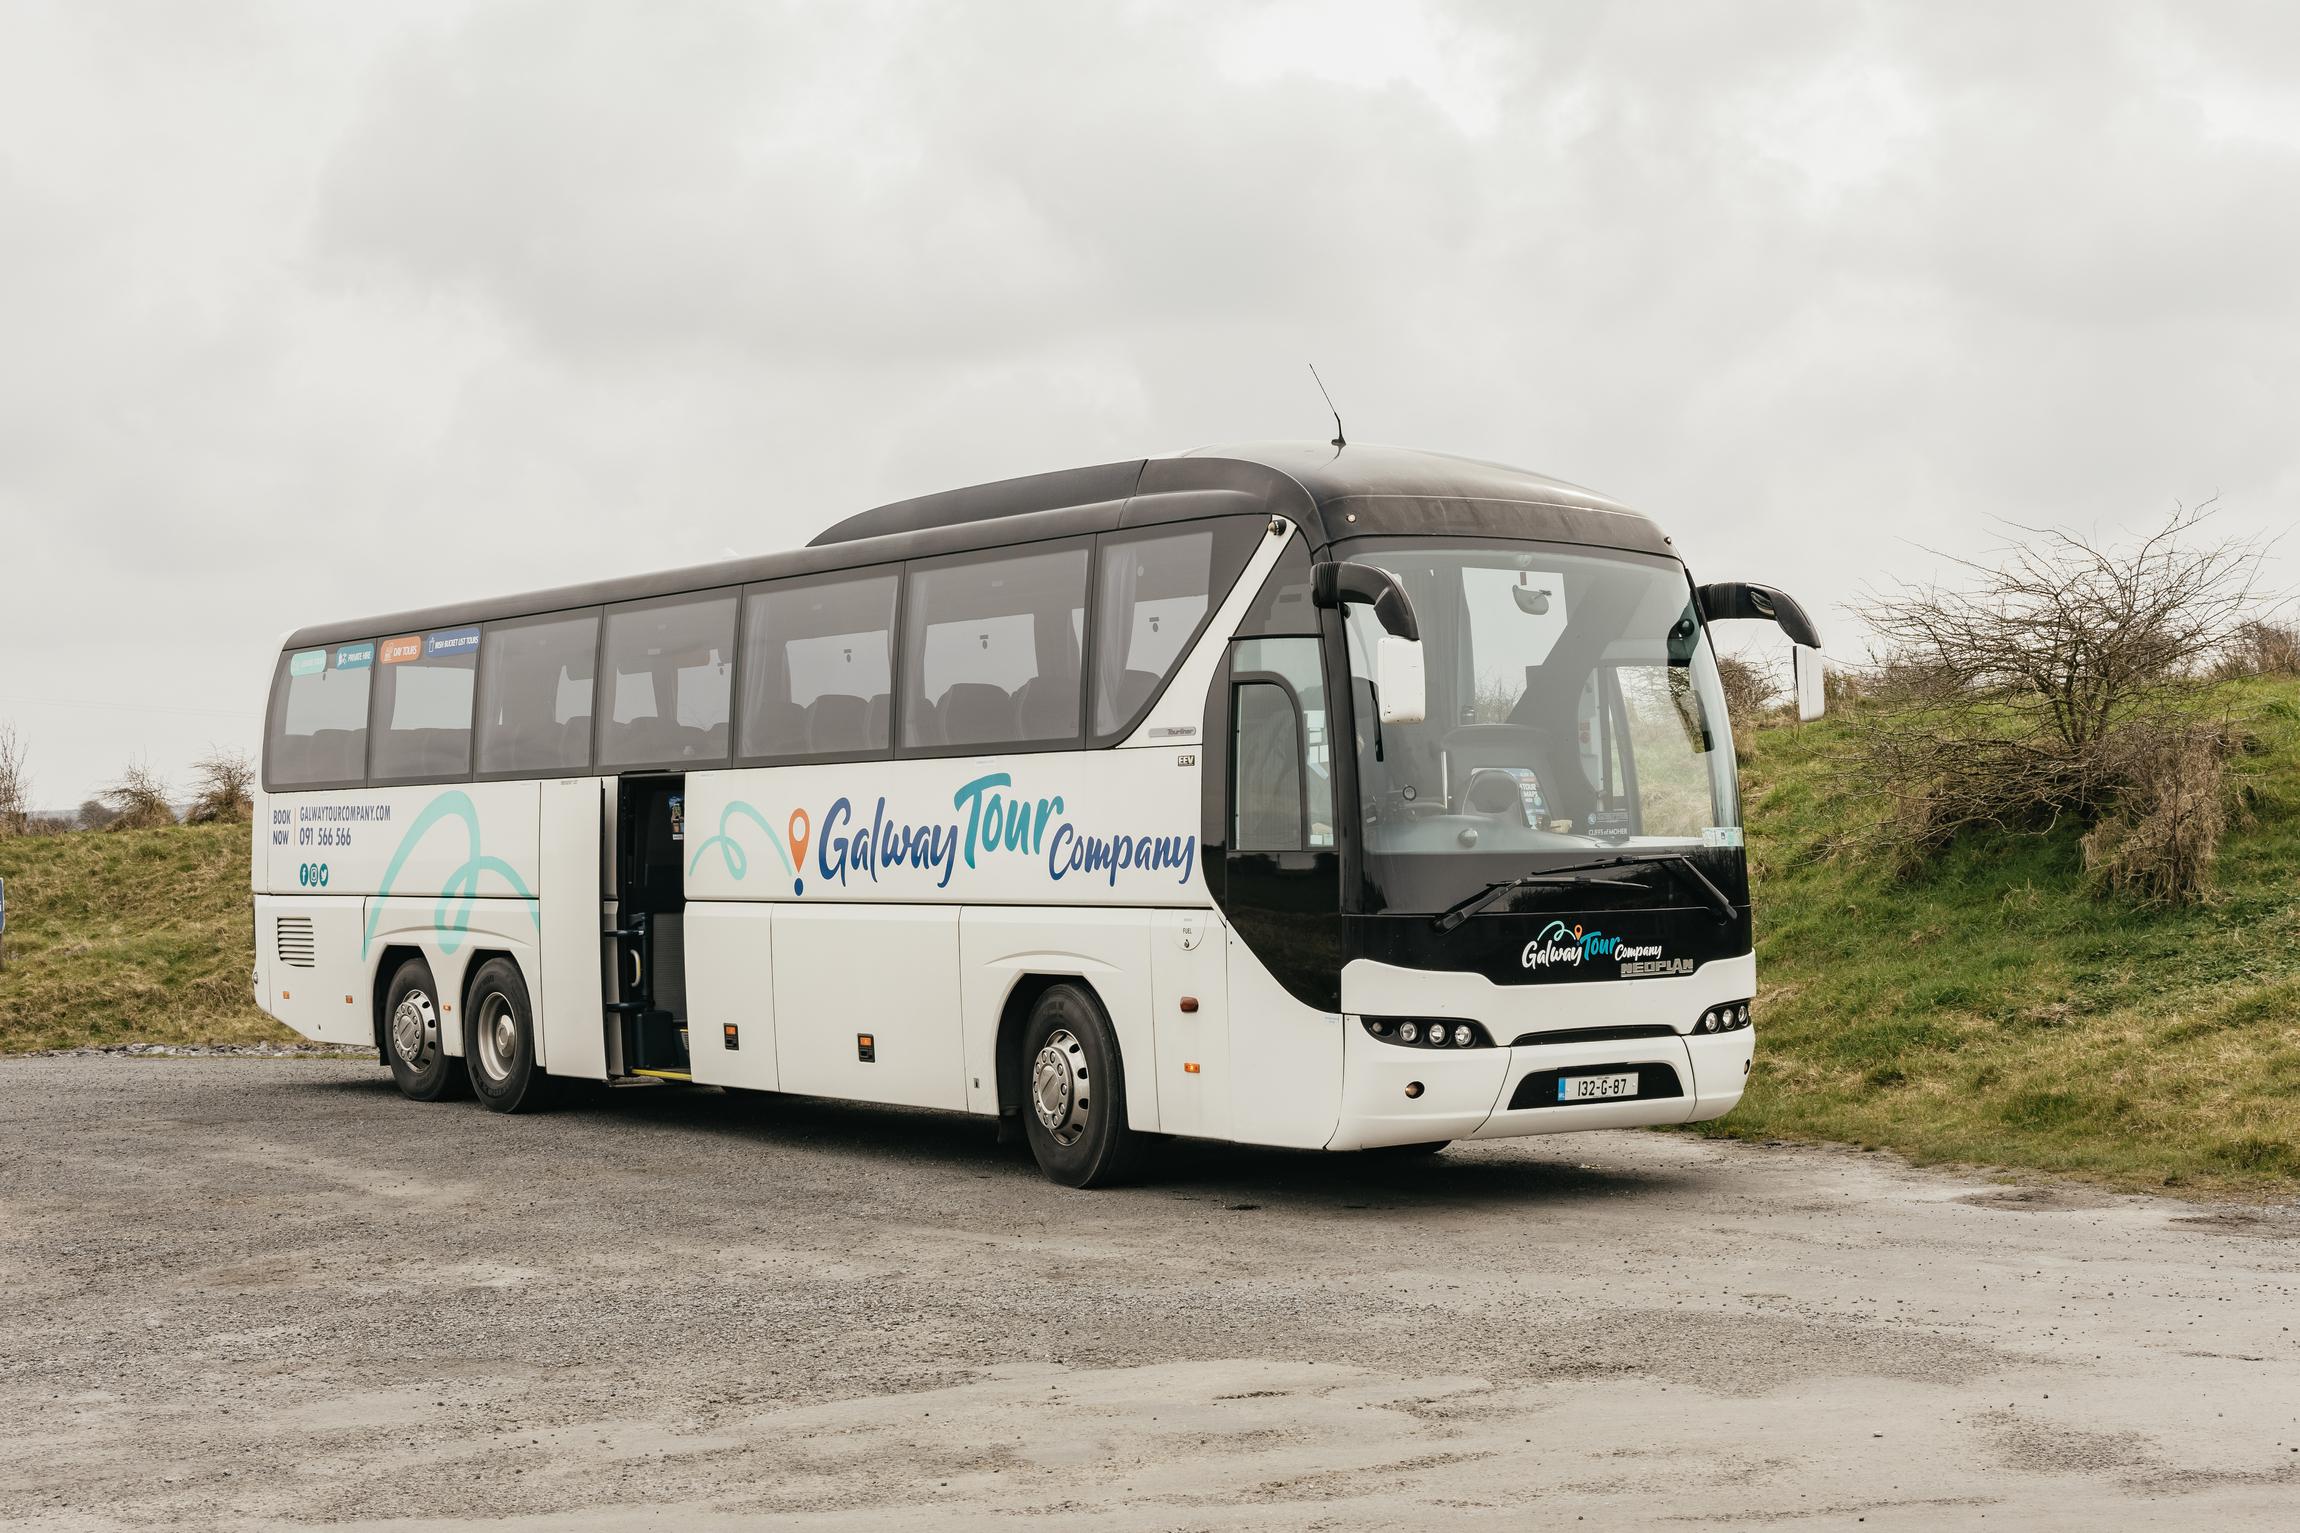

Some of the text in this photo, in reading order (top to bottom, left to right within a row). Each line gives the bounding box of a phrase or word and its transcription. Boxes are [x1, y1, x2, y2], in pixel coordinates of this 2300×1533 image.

[466, 636, 479, 644] TOURS
[348, 652, 363, 662] PRIVATE
[393, 646, 417, 656] DAY TOURS
[1167, 728, 1194, 736] Tourliner
[1178, 755, 1194, 765] EEV
[273, 809, 291, 825] BOOK
[299, 805, 391, 822] GALWAYTOURCOMPANY.COM
[272, 830, 289, 846] NOW
[299, 827, 352, 846] 091 566 566
[818, 772, 1196, 888] Galway Tour Company
[1182, 927, 1192, 935] FUEL
[1521, 931, 1663, 970] Galway Tour Company
[1620, 958, 1694, 977] NEOPLAN
[1578, 1078, 1627, 1097] 132-G-87
